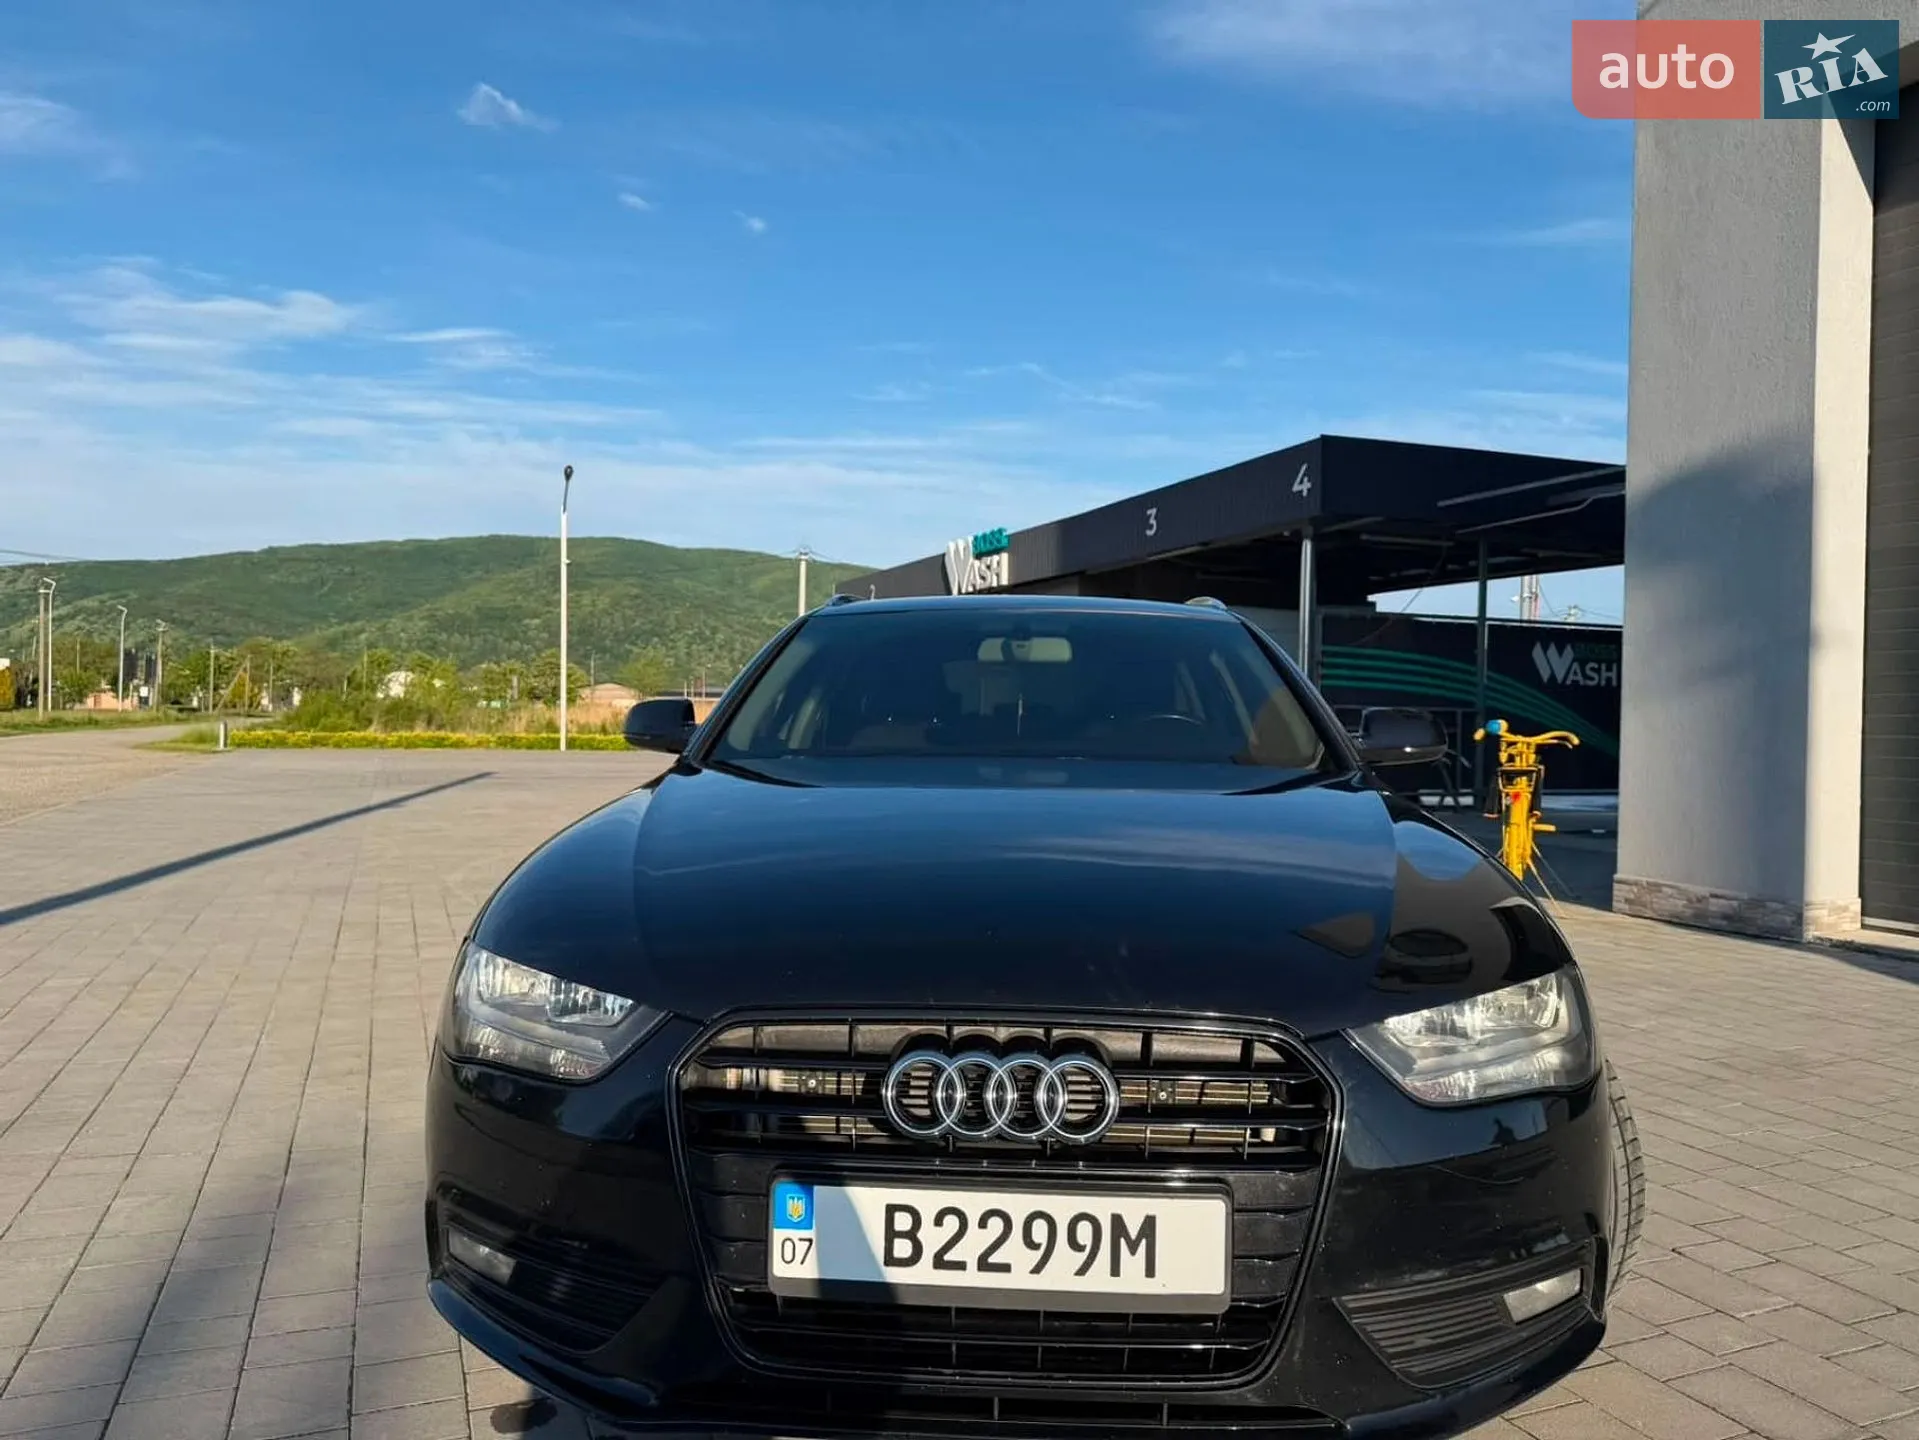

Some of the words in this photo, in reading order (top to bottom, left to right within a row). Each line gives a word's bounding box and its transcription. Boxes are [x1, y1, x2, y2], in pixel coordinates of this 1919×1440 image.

[1291, 462, 1312, 497] 4
[1145, 507, 1158, 536] 3
[1531, 641, 1618, 687] WASH
[780, 1237, 814, 1266] 07
[883, 1203, 1157, 1279] B2299M
